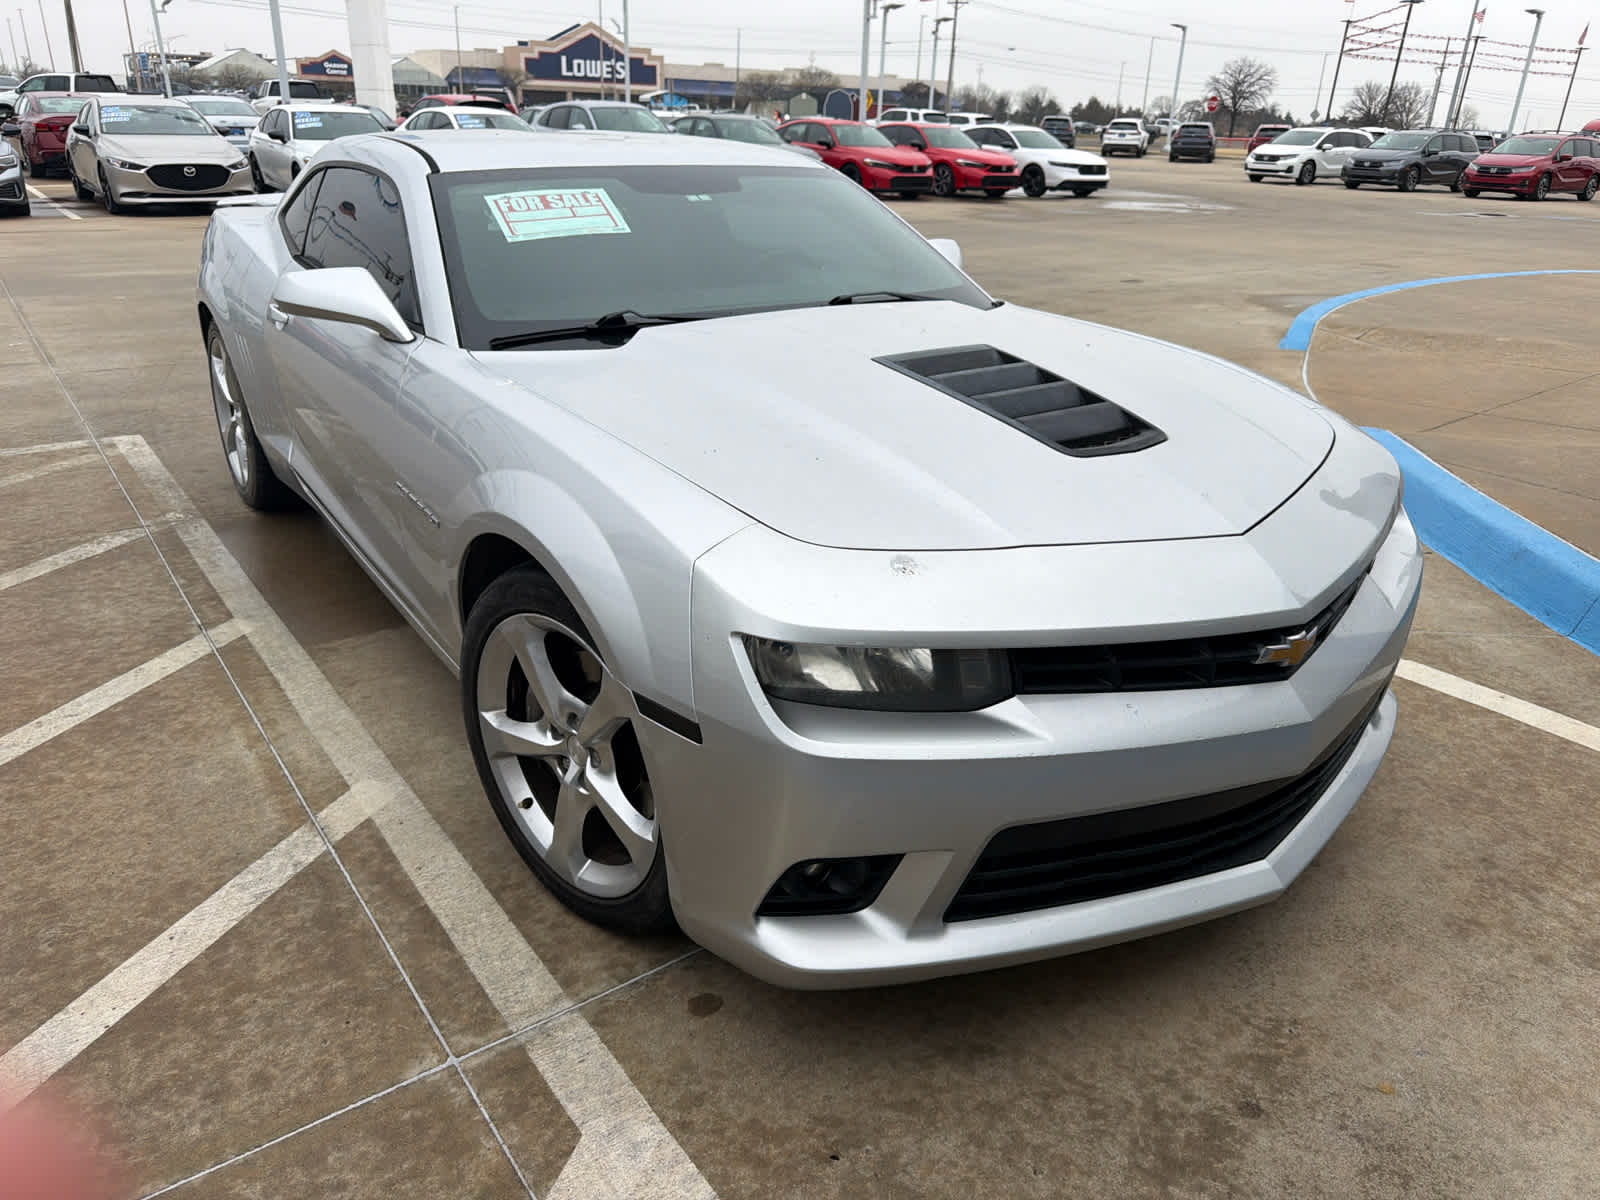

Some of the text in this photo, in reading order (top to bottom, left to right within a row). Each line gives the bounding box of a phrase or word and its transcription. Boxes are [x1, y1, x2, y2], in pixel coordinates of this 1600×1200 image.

[560, 55, 626, 79] LOWE'S
[498, 192, 602, 212] FOR SALE
